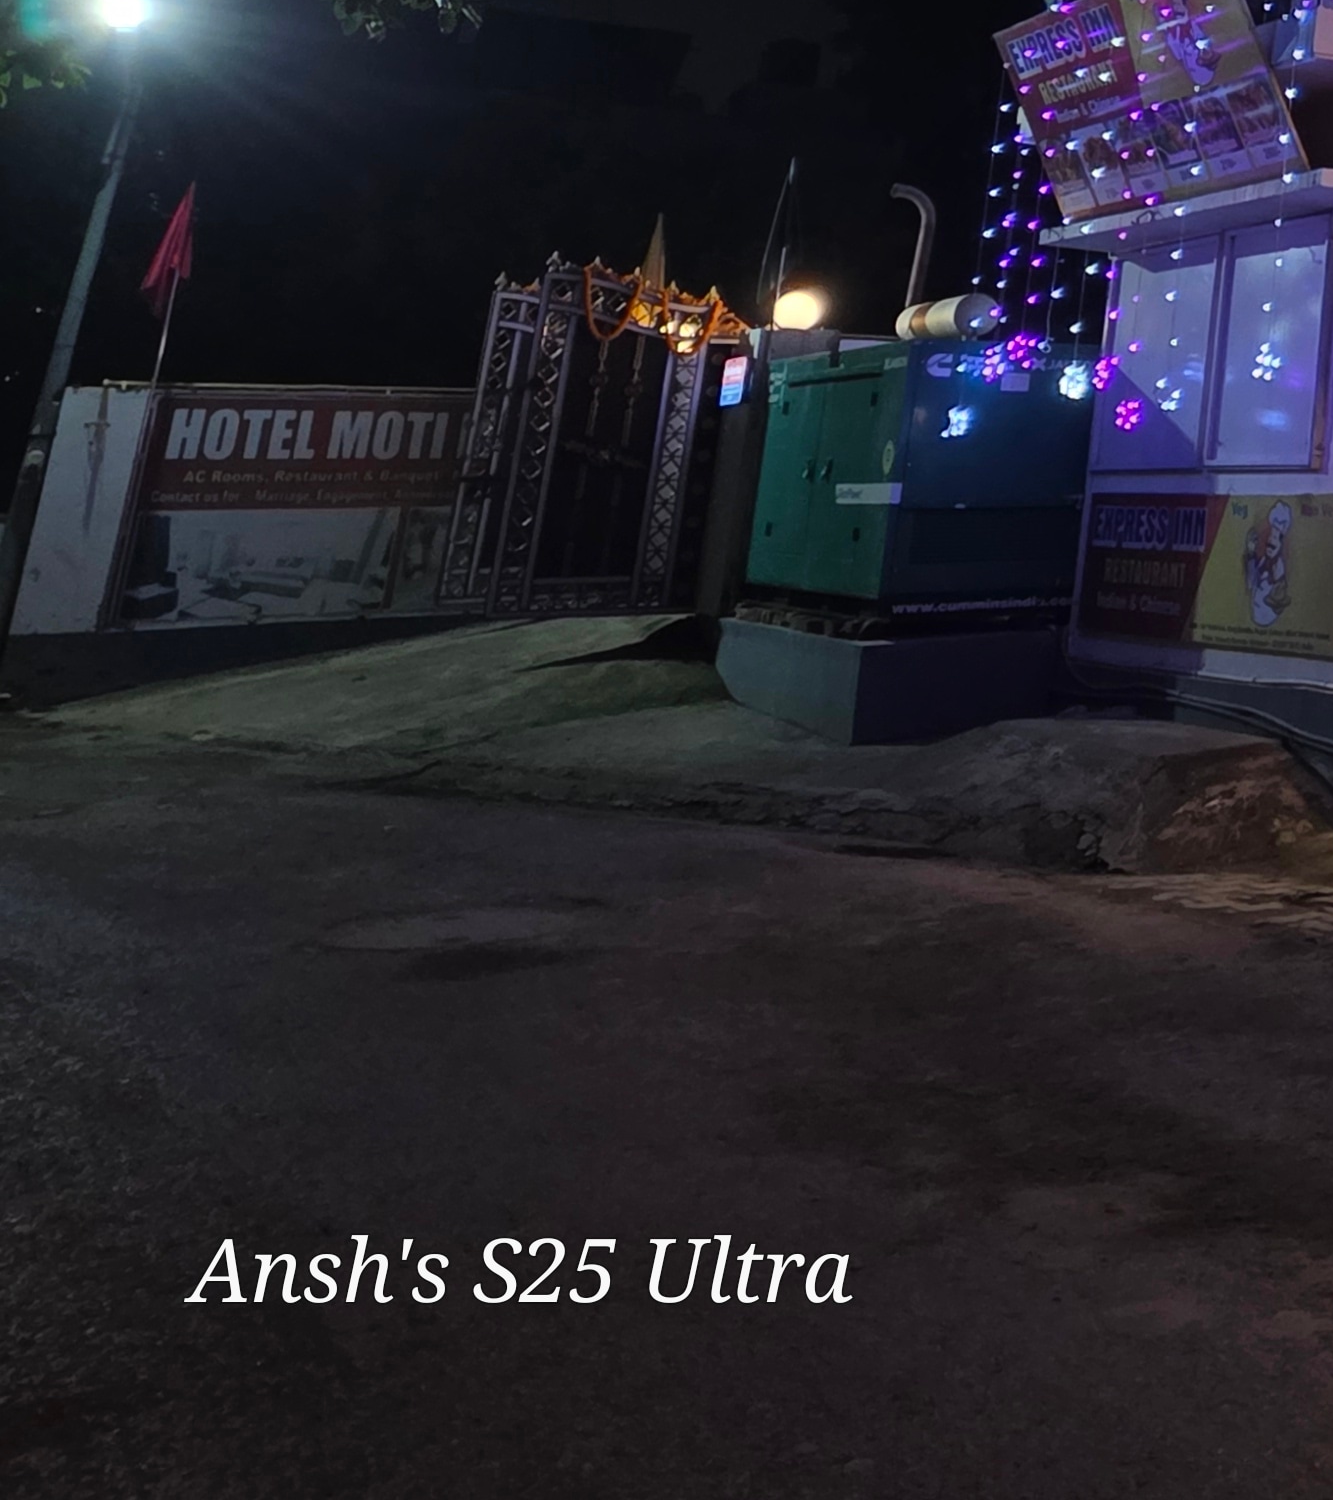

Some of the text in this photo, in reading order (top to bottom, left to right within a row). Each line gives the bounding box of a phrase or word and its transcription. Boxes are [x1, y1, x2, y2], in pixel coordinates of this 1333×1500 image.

[1007, 3, 1120, 80] EXPRESS INN
[164, 407, 316, 461] HOTEL
[326, 409, 450, 461] MOTI
[183, 469, 206, 483] AC
[211, 469, 269, 484] Rooms,
[274, 469, 358, 483] Restaurant
[363, 469, 374, 482] &
[150, 490, 201, 503] Contact
[1092, 505, 1207, 553] EXPRESS INN
[1103, 558, 1187, 588] RESTAURANT
